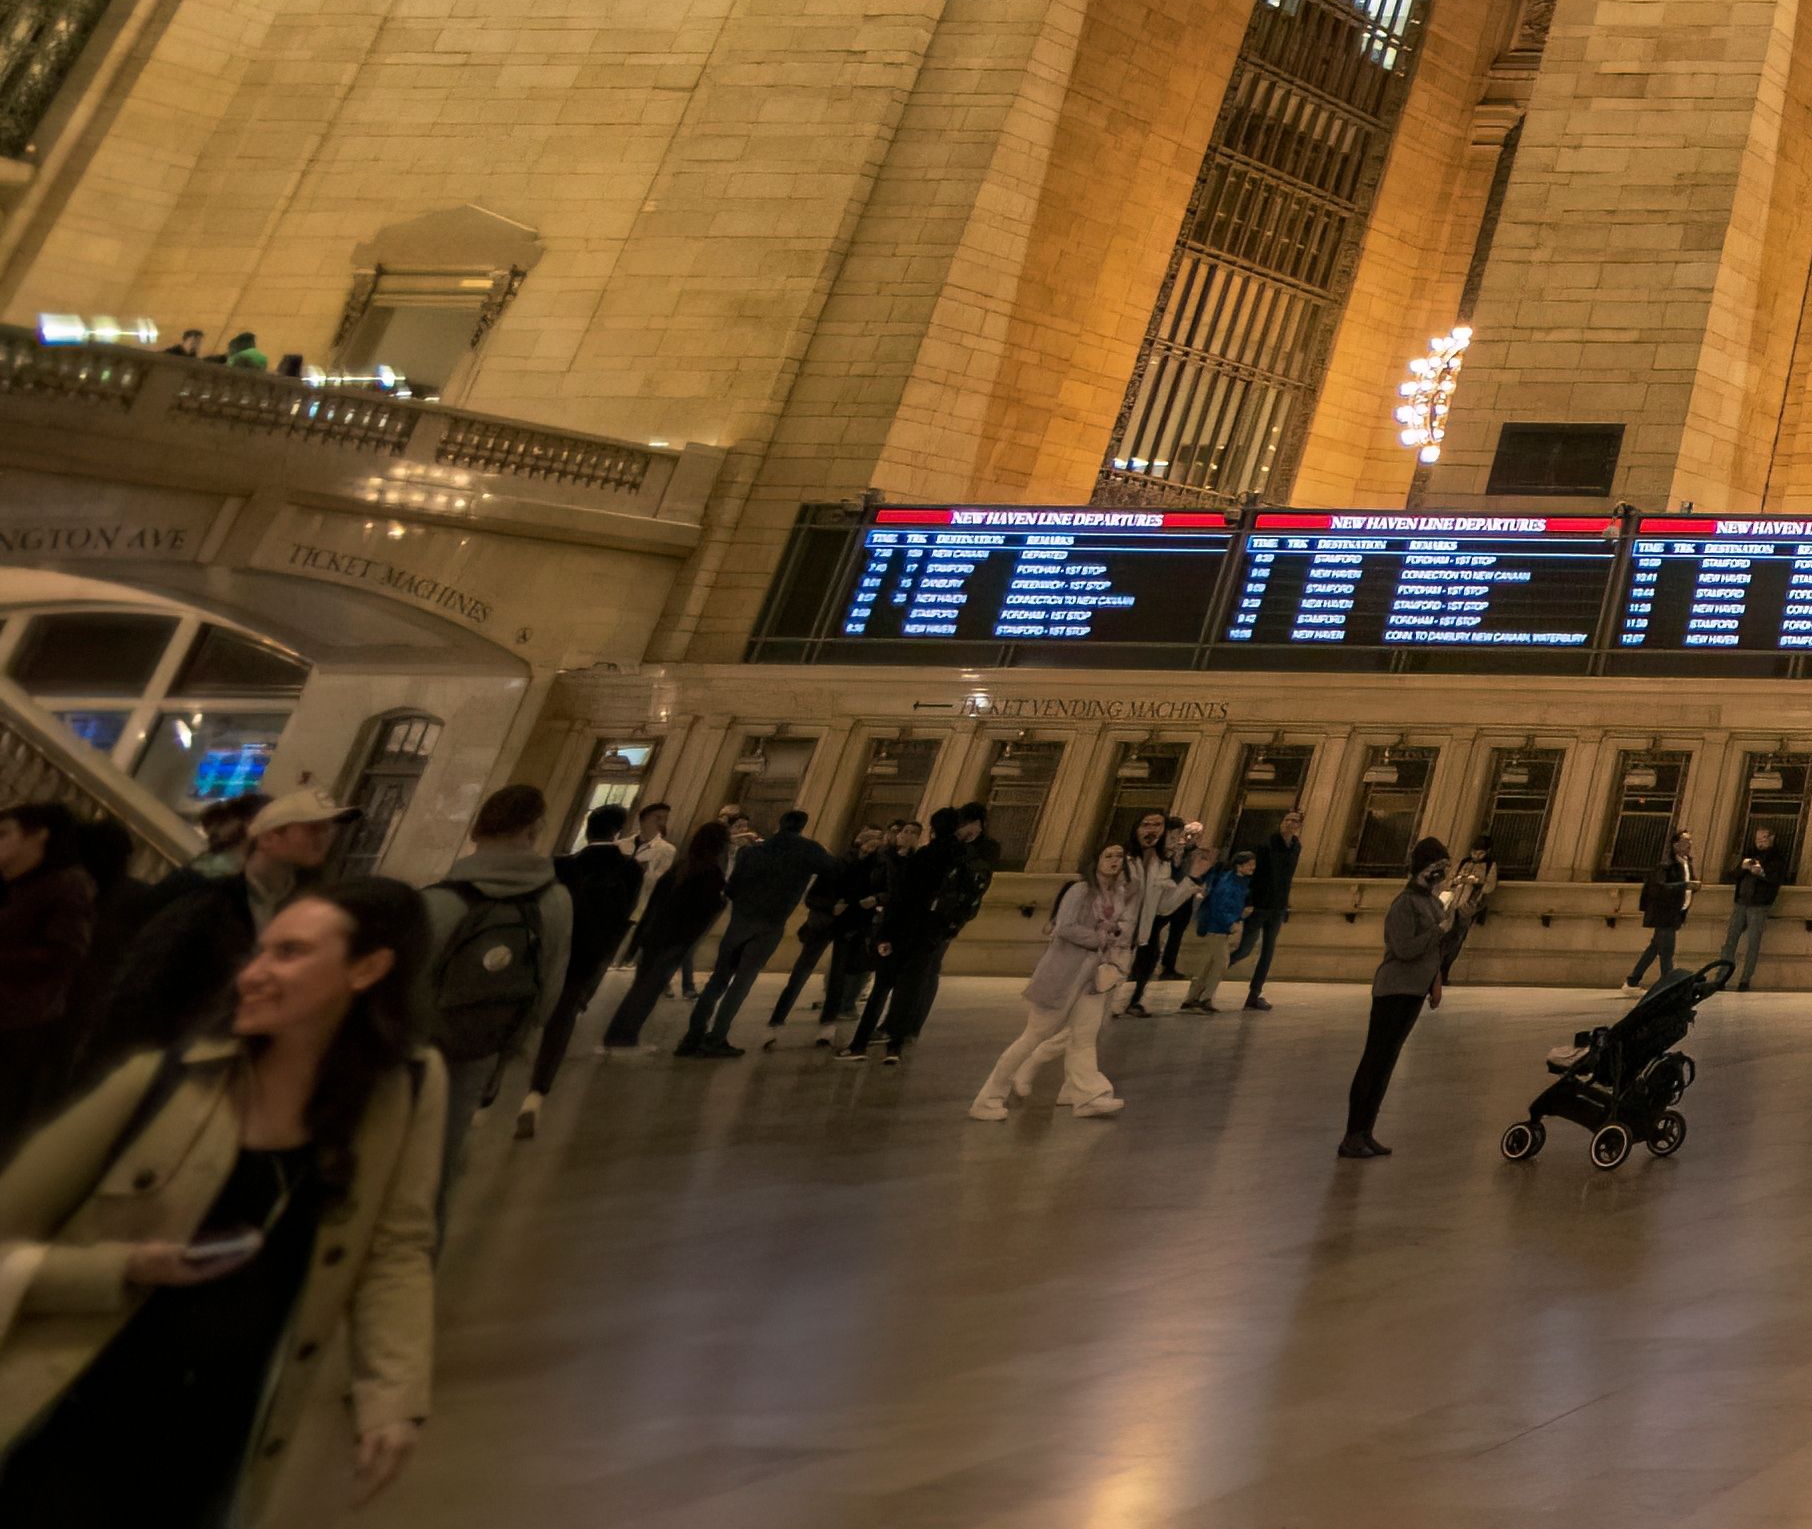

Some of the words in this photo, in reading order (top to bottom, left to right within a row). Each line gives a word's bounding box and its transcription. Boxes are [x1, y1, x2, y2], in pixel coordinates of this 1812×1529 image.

[951, 511, 988, 524] NEW
[987, 511, 1038, 525] HAVEN
[1036, 512, 1073, 525] LINE
[1072, 512, 1164, 526] DEPARTURES
[1331, 516, 1365, 529] NEW
[1366, 517, 1418, 530] HAVEN
[1419, 517, 1455, 530] LINE
[1454, 517, 1546, 531] DEPARTURES
[1716, 520, 1749, 534] NEW
[1752, 521, 1804, 534] HAVEN
[127, 528, 187, 551] AVE
[288, 543, 380, 578] TICKET
[380, 561, 495, 624] MACHINES
[1033, 698, 1122, 718] VENDING
[1127, 700, 1230, 719] MACHINES
